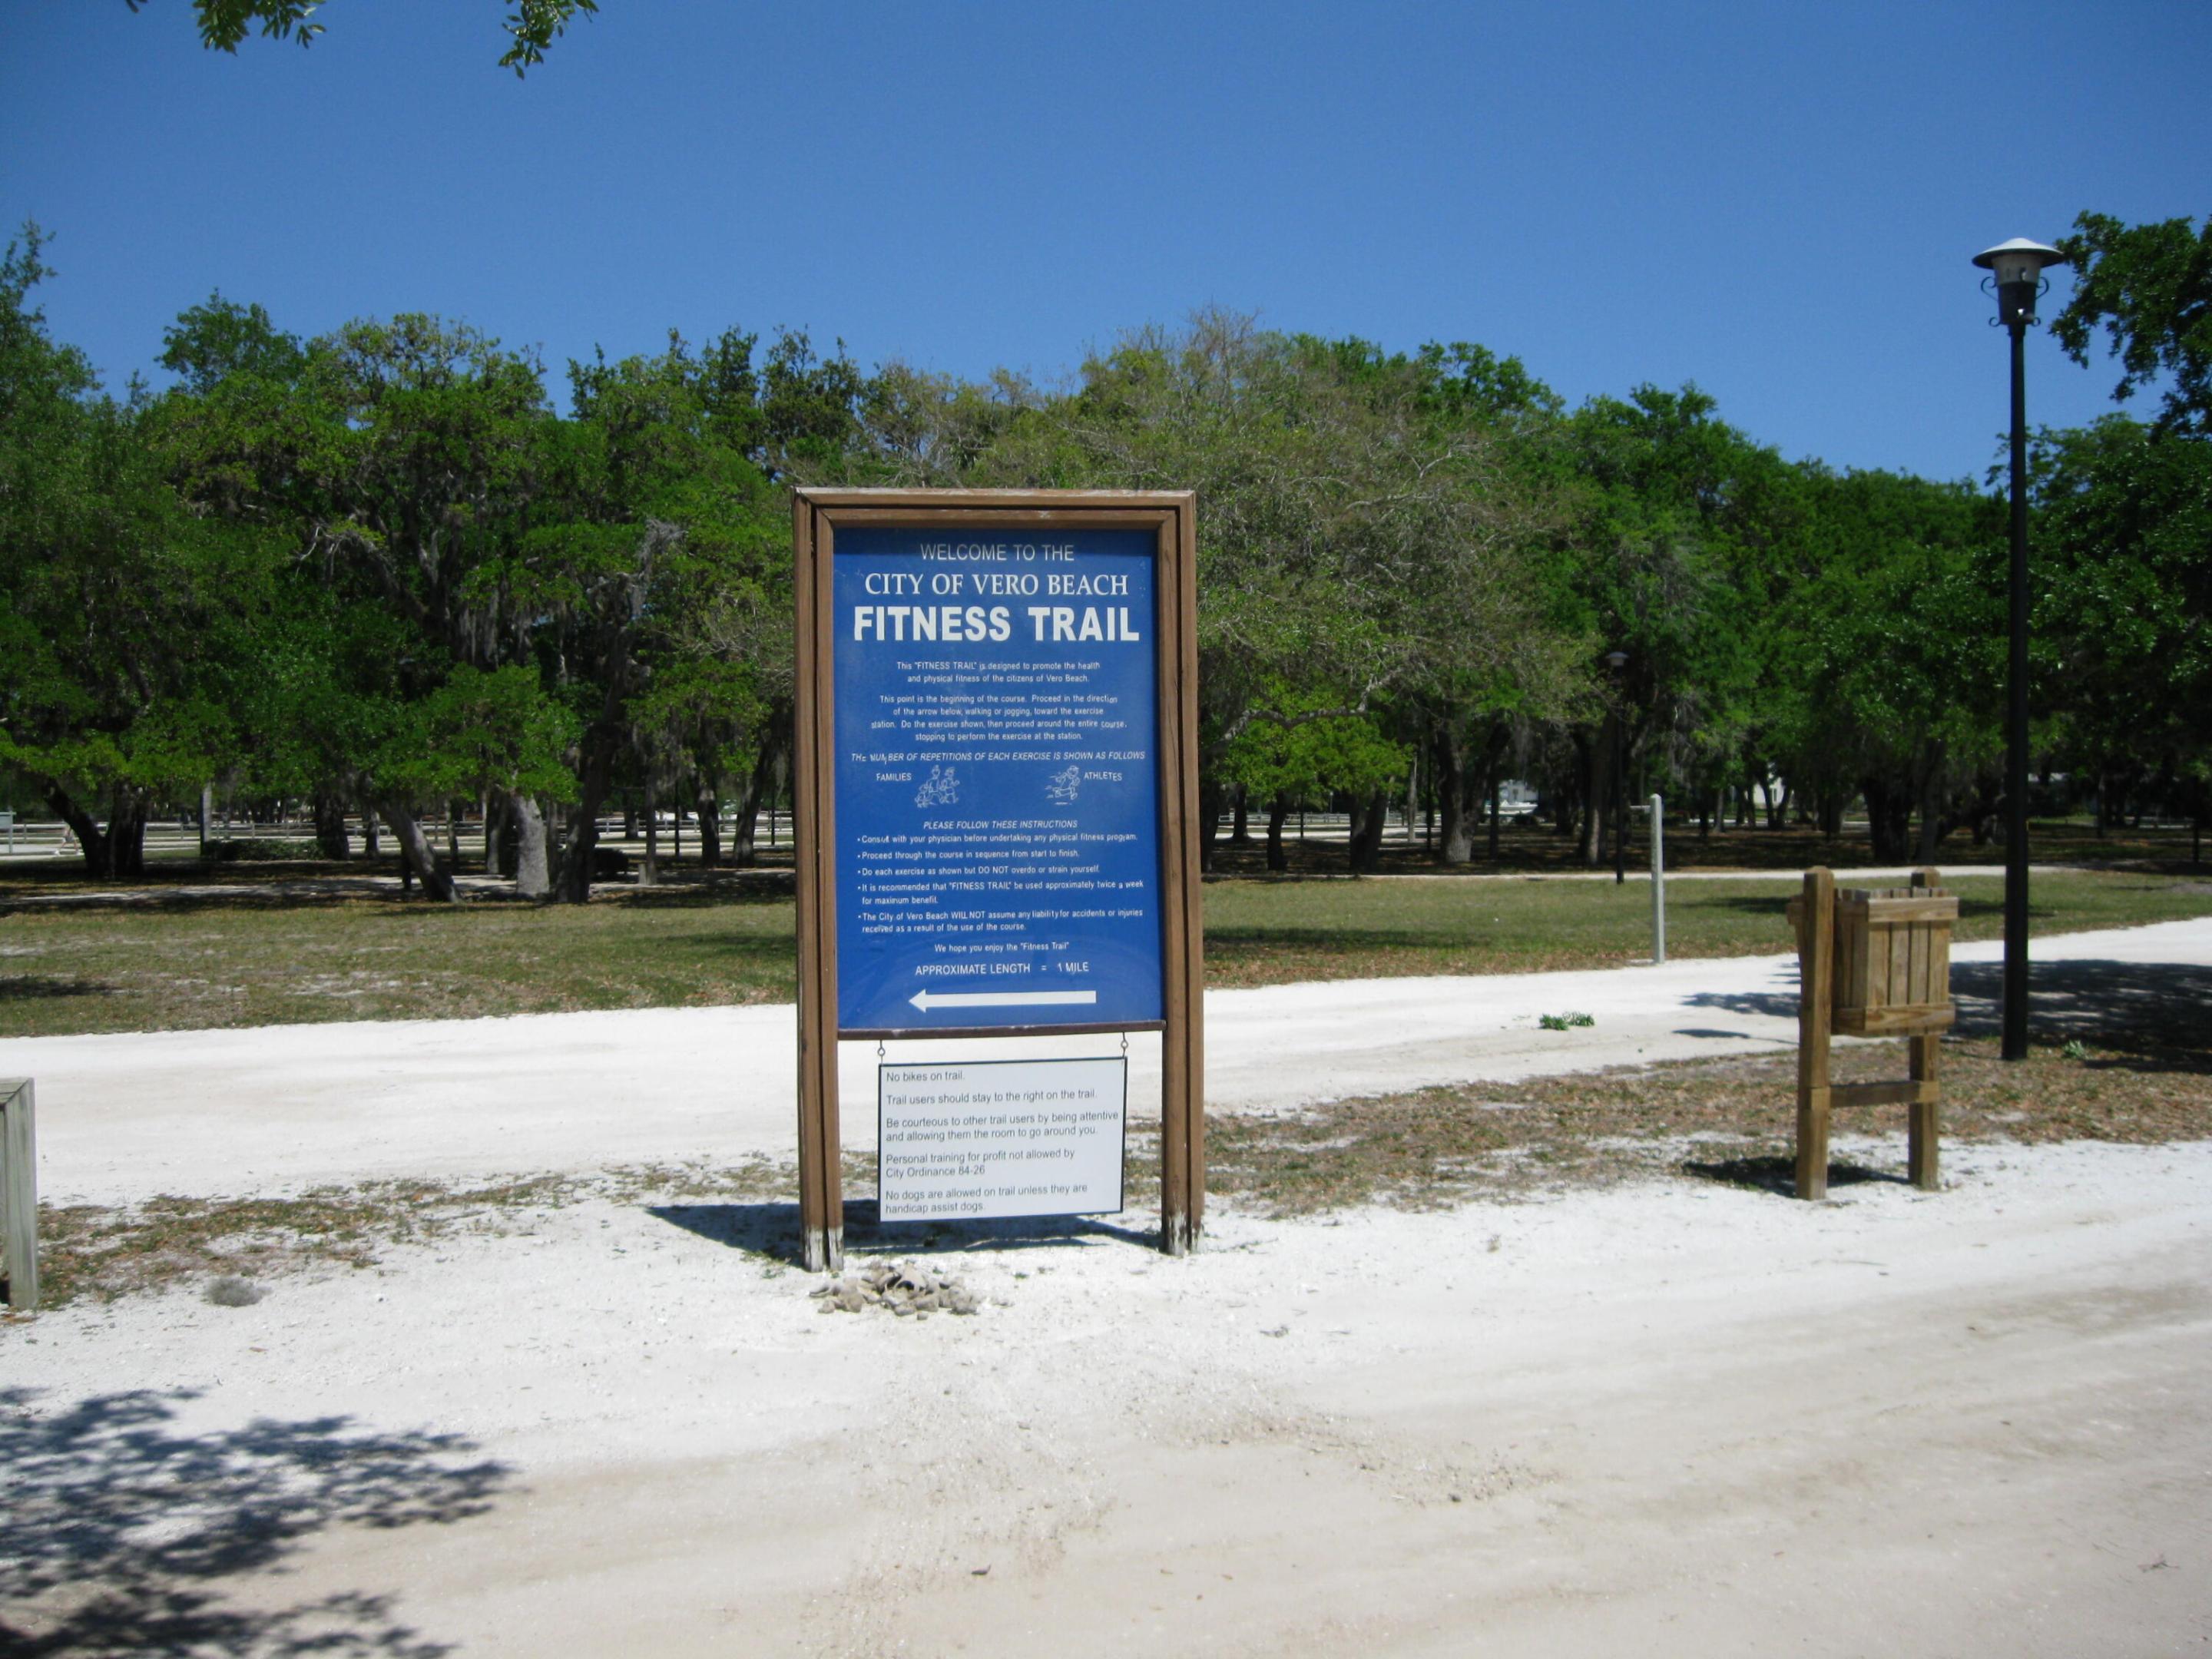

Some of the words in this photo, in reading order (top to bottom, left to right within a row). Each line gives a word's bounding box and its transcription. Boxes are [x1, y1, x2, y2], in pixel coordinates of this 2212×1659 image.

[921, 545, 1008, 561] WELCOME
[1014, 545, 1035, 561] TO
[1043, 545, 1075, 561] THE
[865, 573, 923, 594] CITY
[932, 574, 963, 594] OF
[972, 574, 1038, 595] VERO
[1048, 575, 1128, 595] BEACH
[854, 606, 1011, 641] FITNESS
[1028, 607, 1140, 641] TRAIL
[897, 661, 912, 670] This
[987, 662, 1021, 671] designed
[1032, 662, 1061, 671] promote
[923, 675, 953, 684] physical
[916, 733, 945, 743] stopping
[956, 733, 986, 741] perform
[852, 753, 866, 762] THE
[906, 753, 919, 761] OF
[920, 752, 972, 761] REPETITIONS
[974, 752, 986, 760] OF
[988, 752, 1010, 760] EACH
[1012, 752, 1051, 760] EXERCISE
[1054, 752, 1061, 760] IS
[1095, 751, 1106, 760] AS
[1108, 751, 1145, 760] FOLLOWS
[876, 773, 912, 782] FAMILIES
[1084, 771, 1122, 781] ATHLETES
[923, 821, 955, 830] PLEASE
[956, 820, 989, 830] FOLLOW
[992, 820, 1018, 829] THESE
[1020, 820, 1078, 829] INSTRUCTIONS
[862, 851, 892, 859] Proceed
[895, 851, 922, 861] through
[1012, 849, 1028, 858] from
[862, 868, 873, 876] Do
[992, 866, 1008, 874] NOT
[913, 924, 935, 932] result
[936, 923, 944, 932] of
[946, 923, 959, 932] the
[976, 922, 984, 931] of
[934, 944, 946, 952] We
[949, 945, 967, 953] hope
[985, 944, 1004, 953] enjoy
[916, 964, 986, 976] APPROXIMATE
[991, 963, 1031, 974] LENGTH
[1065, 962, 1089, 974] MILE
[886, 1072, 900, 1082] No
[903, 1071, 928, 1081] bikes
[930, 1073, 942, 1081] on
[886, 1094, 906, 1105] Trail
[909, 1096, 935, 1104] users
[939, 1093, 969, 1104] should
[972, 1093, 992, 1104] stay
[995, 1092, 1003, 1102] to
[1006, 1091, 1021, 1101] the
[1022, 1091, 1044, 1103] right
[1046, 1091, 1058, 1100] on
[1061, 1089, 1075, 1099] the
[886, 1118, 899, 1128] Be
[902, 1117, 949, 1128] courteous
[951, 1117, 961, 1126] to
[963, 1115, 988, 1125] other
[990, 1114, 1007, 1124] trail
[1009, 1115, 1035, 1124] users
[1038, 1114, 1049, 1125] by
[1051, 1112, 1077, 1124] being
[1080, 1110, 1118, 1121] attentive
[886, 1131, 904, 1142] and
[906, 1131, 945, 1144] allowing
[948, 1130, 972, 1140] them
[974, 1129, 989, 1139] the
[990, 1130, 1015, 1138] room
[1018, 1128, 1027, 1137] to
[1029, 1128, 1041, 1139] go
[1044, 1127, 1076, 1136] around
[886, 1153, 928, 1165] Personal
[931, 1153, 965, 1166] training
[968, 1151, 980, 1161] for
[983, 1151, 1006, 1163] profit
[1009, 1151, 1023, 1160] not
[1026, 1149, 1061, 1159] allowed
[1064, 1148, 1075, 1160] by
[886, 1167, 905, 1181] City
[907, 1166, 955, 1177] Ordinance
[886, 1190, 899, 1200] No
[902, 1190, 925, 1203] dogs
[945, 1187, 982, 1198] allowed
[998, 1186, 1015, 1196] trail
[1018, 1185, 1048, 1196] unless
[1051, 1184, 1071, 1196] they
[885, 1200, 929, 1216] handicap
[931, 1203, 958, 1212] assist
